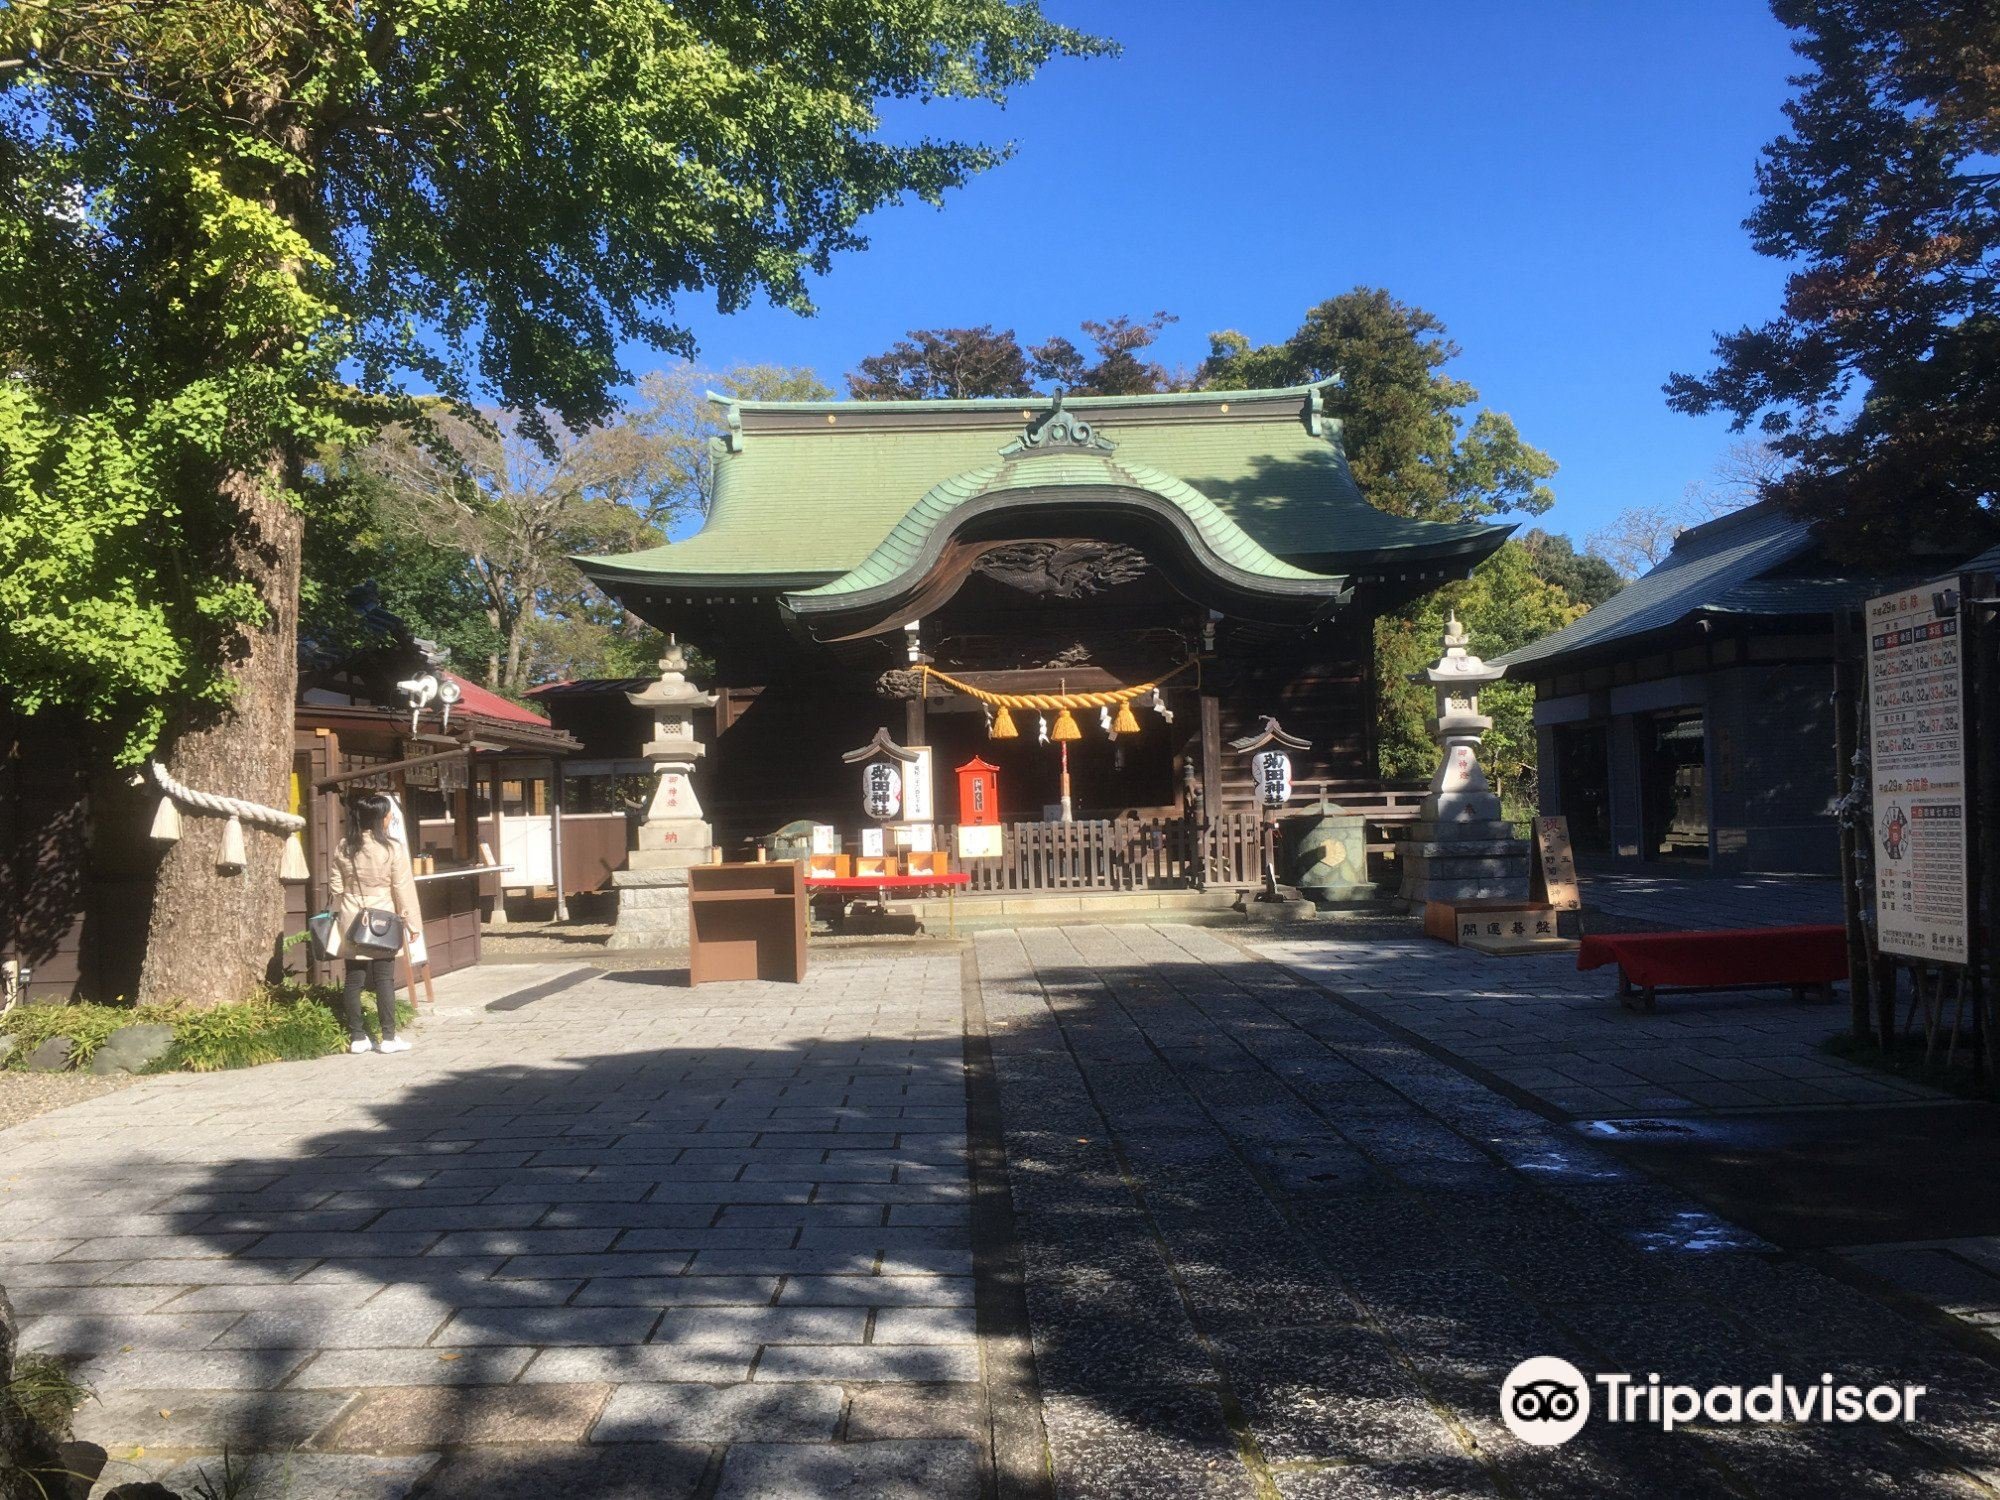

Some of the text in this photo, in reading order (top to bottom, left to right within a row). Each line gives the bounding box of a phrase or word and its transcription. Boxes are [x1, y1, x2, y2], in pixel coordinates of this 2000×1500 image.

[1900, 594, 1918, 611] 厄除
[1906, 777, 1929, 792] 方位除
[1543, 818, 1560, 832] 祝
[664, 831, 678, 844] 納
[1462, 920, 1551, 937] 開運碁盤
